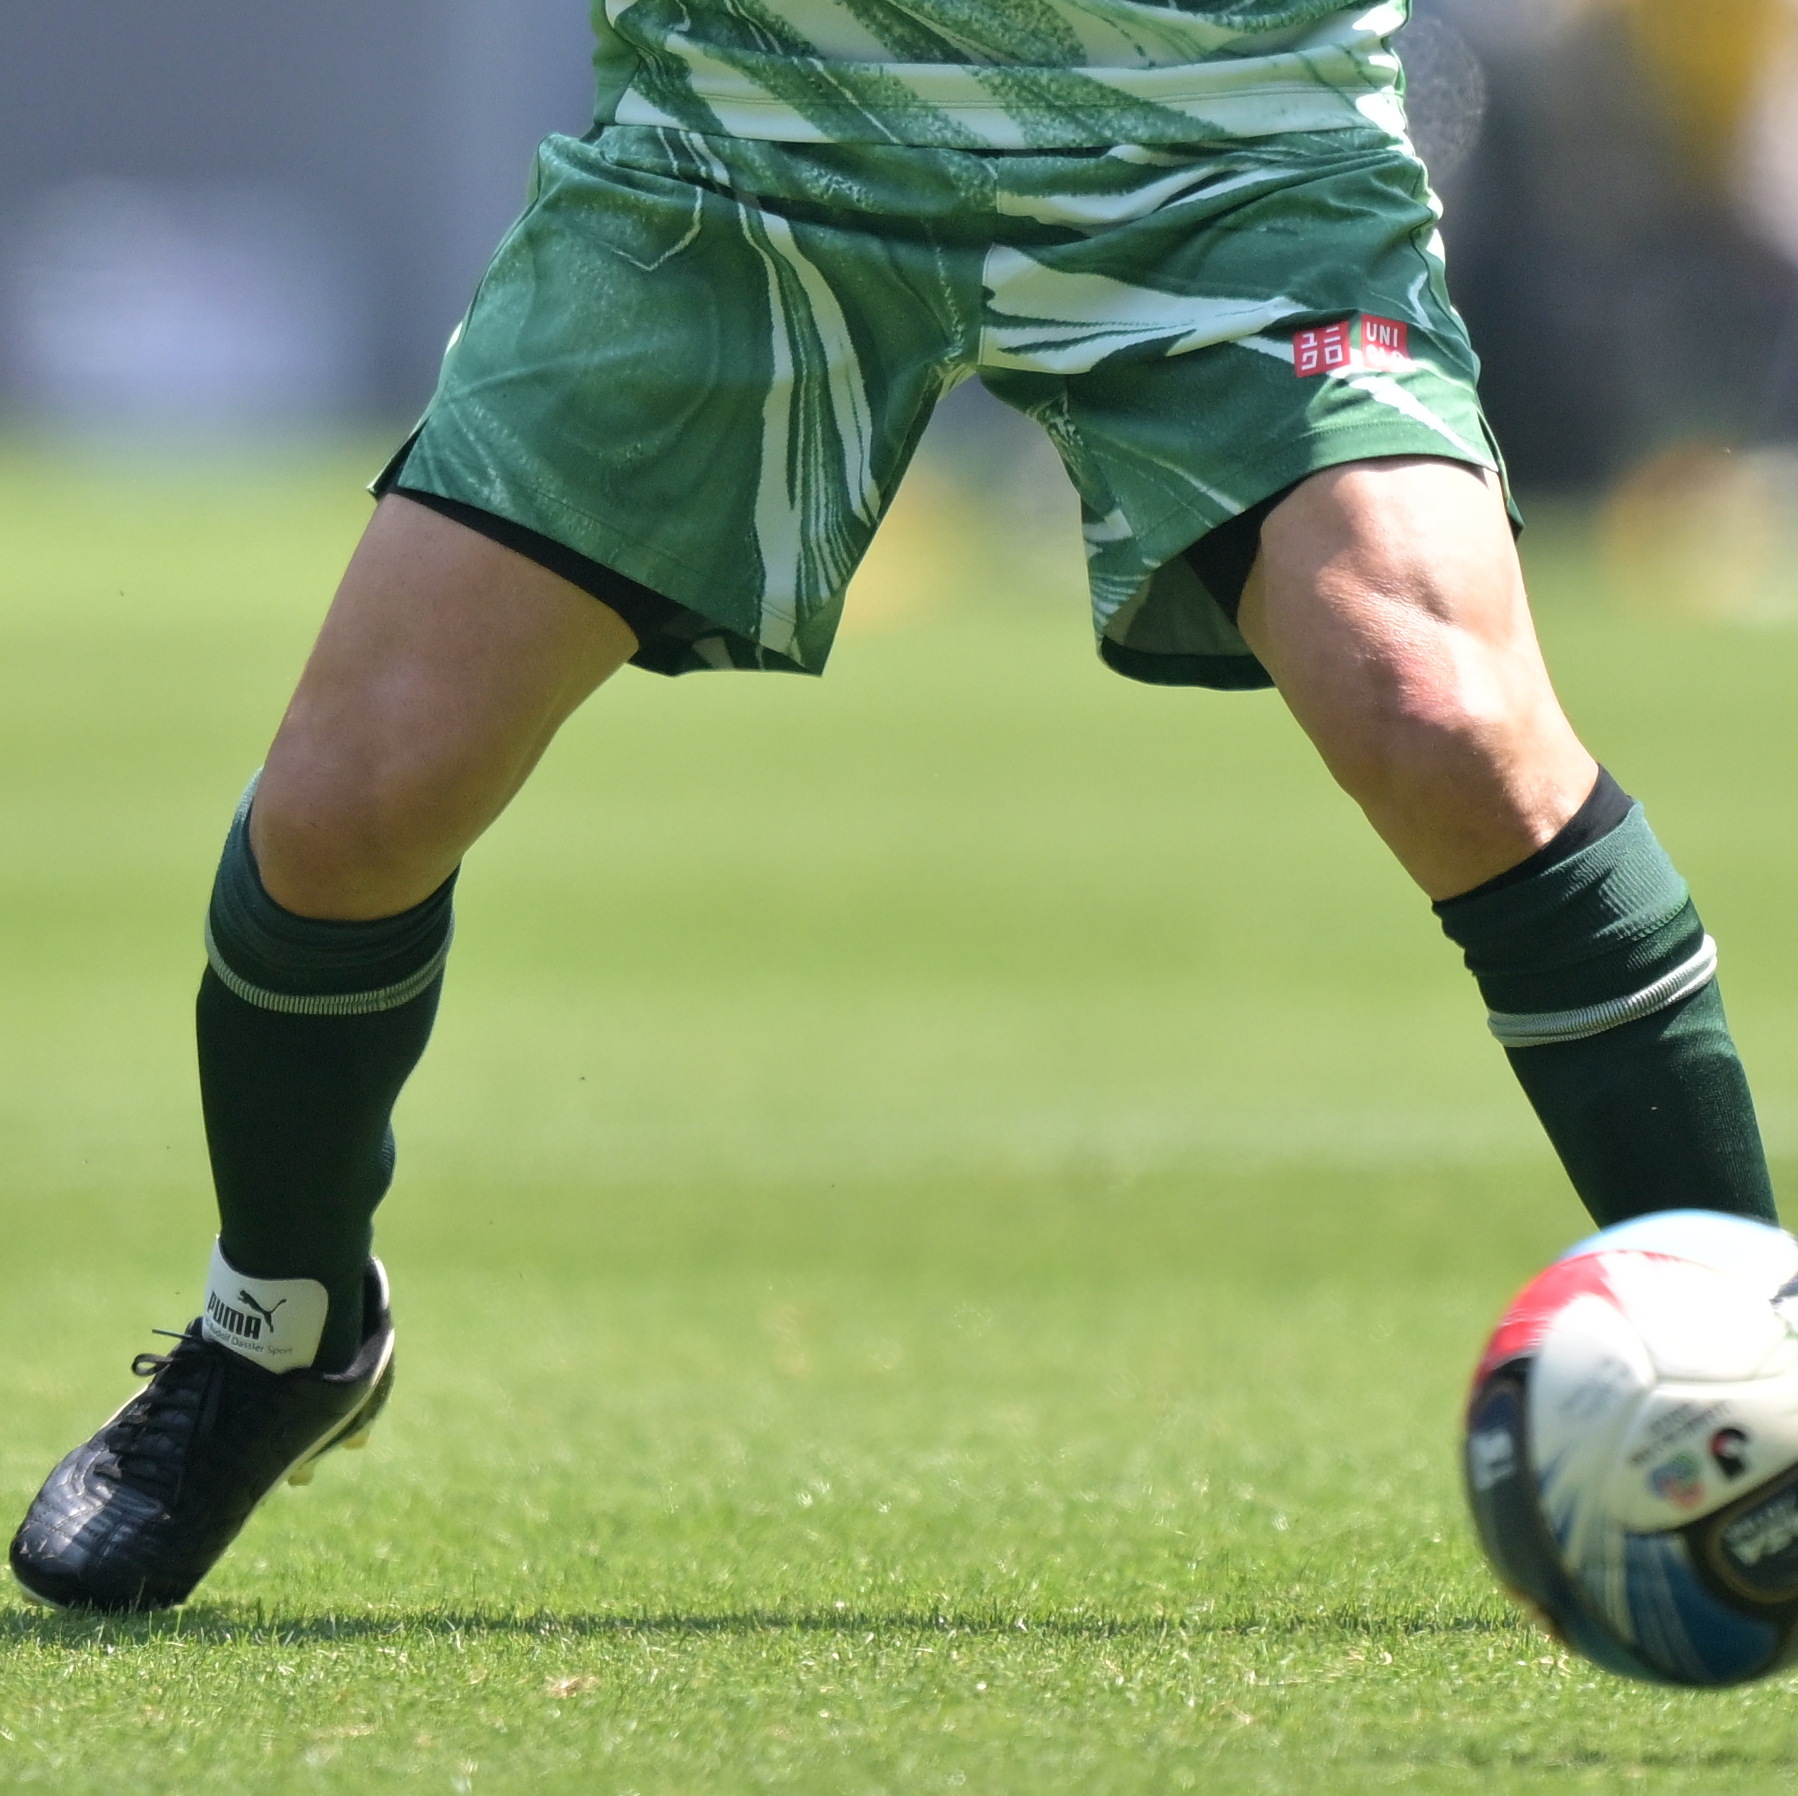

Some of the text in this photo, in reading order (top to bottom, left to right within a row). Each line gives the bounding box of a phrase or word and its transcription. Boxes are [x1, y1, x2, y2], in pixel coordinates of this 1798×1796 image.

[1301, 326, 1341, 349] ユニ
[1366, 321, 1398, 348] UNI
[1301, 344, 1344, 371] クロ
[207, 1290, 262, 1340] PUMA
